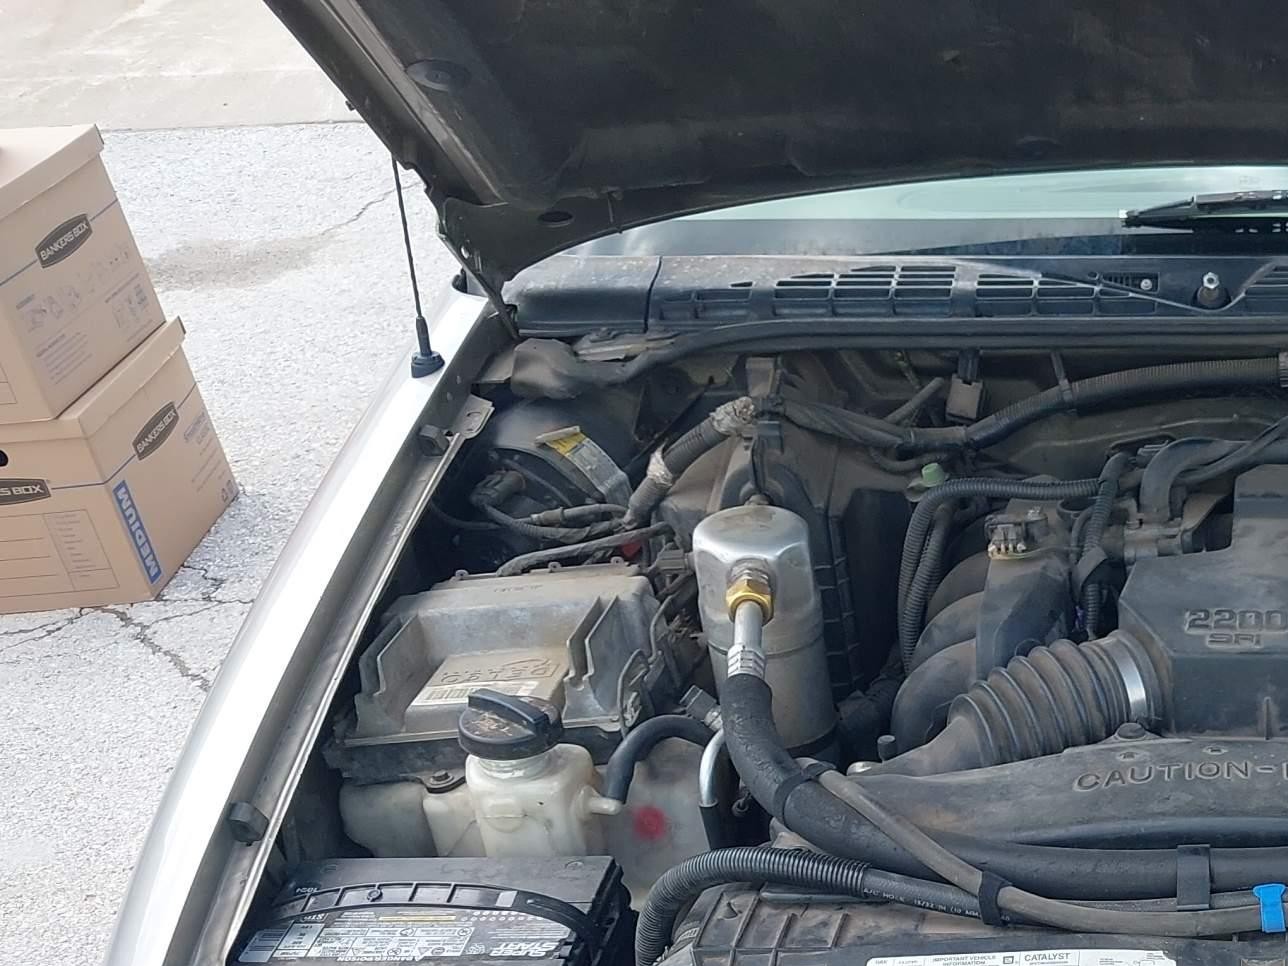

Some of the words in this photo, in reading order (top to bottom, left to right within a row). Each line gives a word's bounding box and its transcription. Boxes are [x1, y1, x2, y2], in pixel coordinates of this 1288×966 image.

[40, 231, 74, 261] BANKERS
[72, 220, 89, 238] BOX
[136, 420, 166, 453] BANKERS
[162, 408, 177, 426] BOX
[12, 484, 44, 496] BOX
[116, 486, 158, 578] MEDIUM
[1185, 608, 1288, 634] 2200
[489, 947, 547, 957] SUPER
[499, 941, 560, 952] START
[933, 955, 969, 963] IMPORTANT
[969, 954, 997, 962] VEHICLE
[1024, 952, 1071, 963] CATALYST
